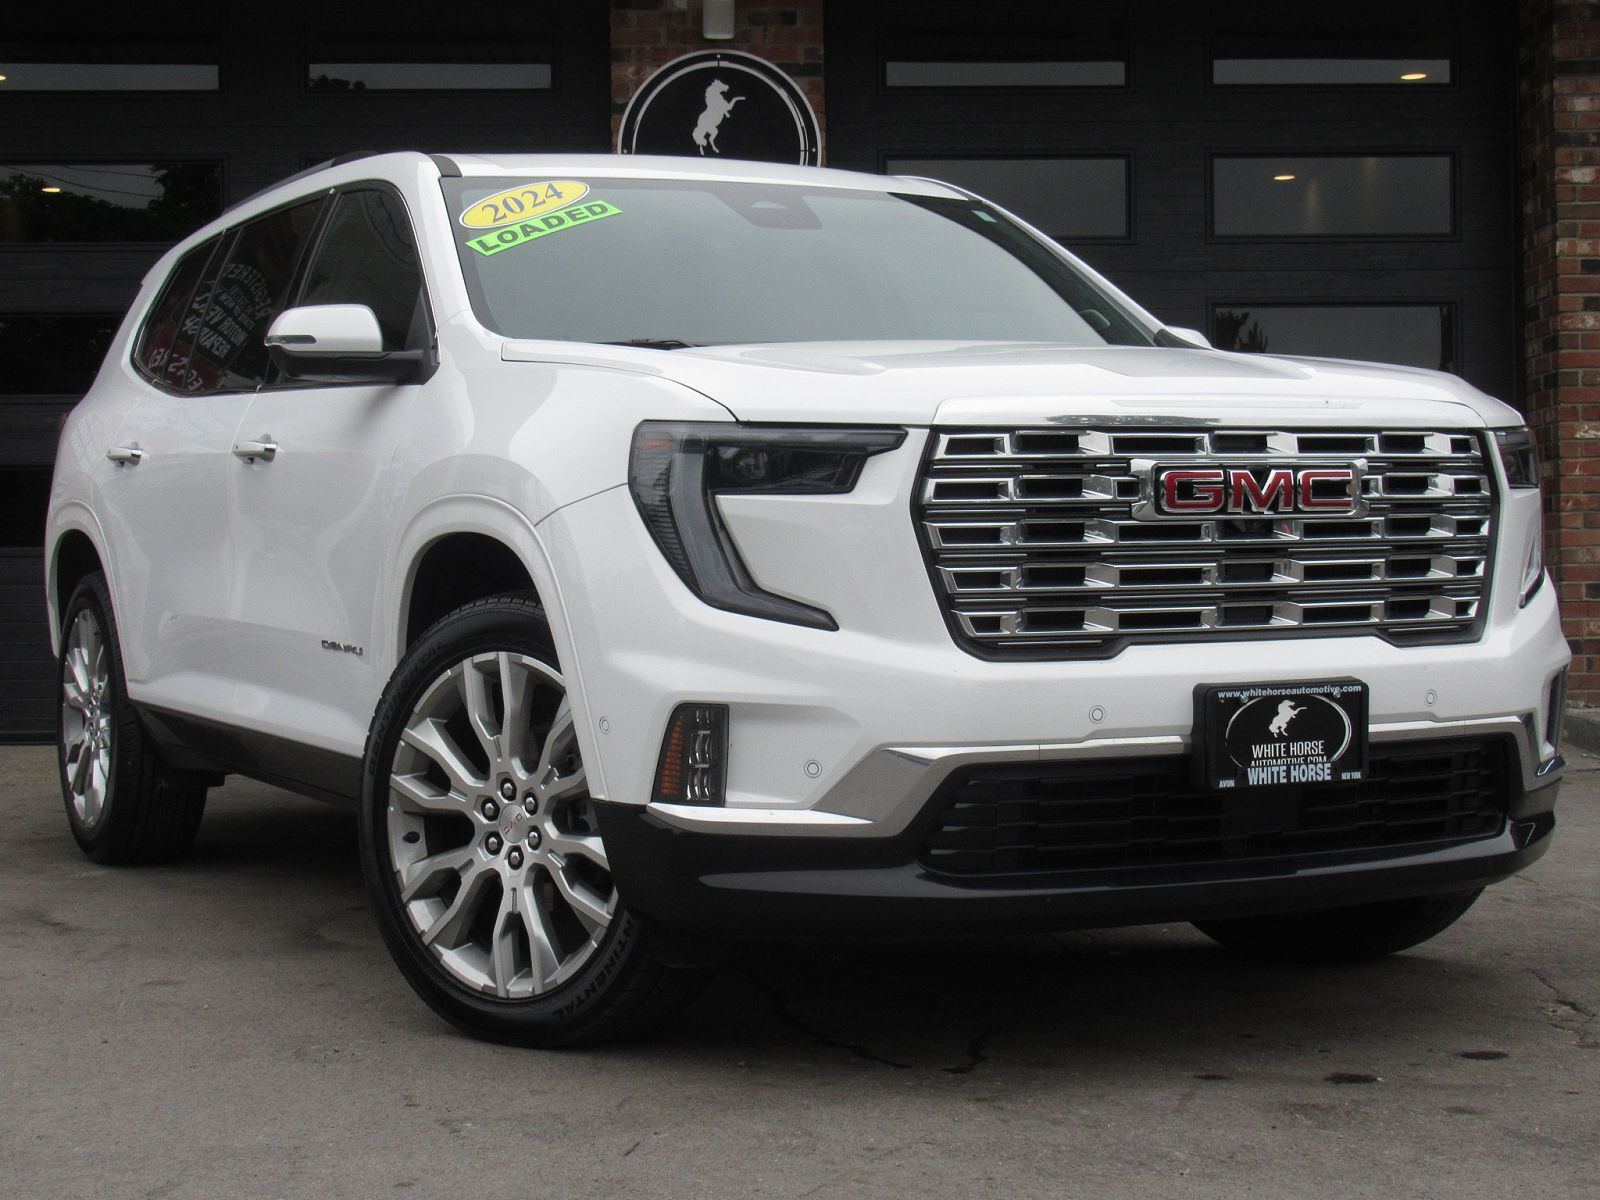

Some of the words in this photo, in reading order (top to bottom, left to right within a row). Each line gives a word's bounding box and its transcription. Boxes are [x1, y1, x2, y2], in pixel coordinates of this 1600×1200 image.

[481, 183, 564, 223] 2024
[476, 203, 609, 252] LOADED
[1160, 469, 1354, 514] GMC
[1217, 684, 1362, 699] www.whitehorseautomotive.com
[1251, 743, 1287, 759] WHITE
[1289, 740, 1325, 757] HORSE
[1247, 765, 1288, 785] WHITE
[1290, 763, 1332, 783] HORSE
